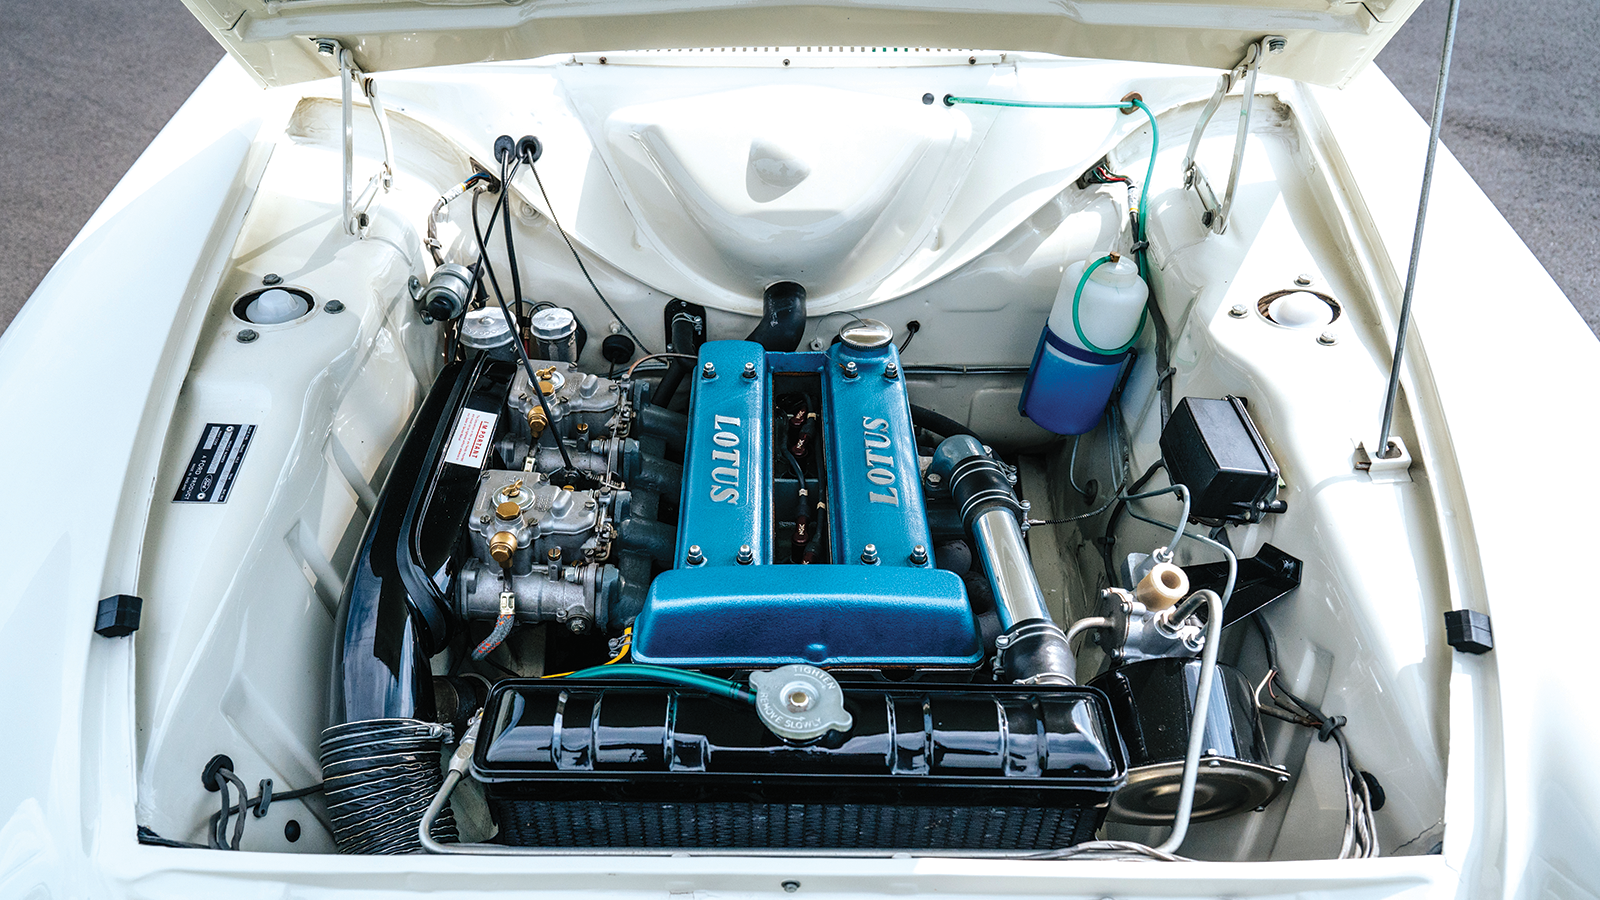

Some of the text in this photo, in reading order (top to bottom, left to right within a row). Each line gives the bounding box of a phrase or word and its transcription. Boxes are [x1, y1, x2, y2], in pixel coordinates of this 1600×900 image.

[471, 420, 489, 458] IMPORTANT
[194, 459, 207, 475] FORD
[710, 414, 742, 505] LOTUS
[862, 416, 900, 508] LOTUS
[184, 476, 198, 500] PRODUCT
[793, 665, 836, 690] TIGHTEN
[760, 692, 822, 729] REMOVE SLOWLY
